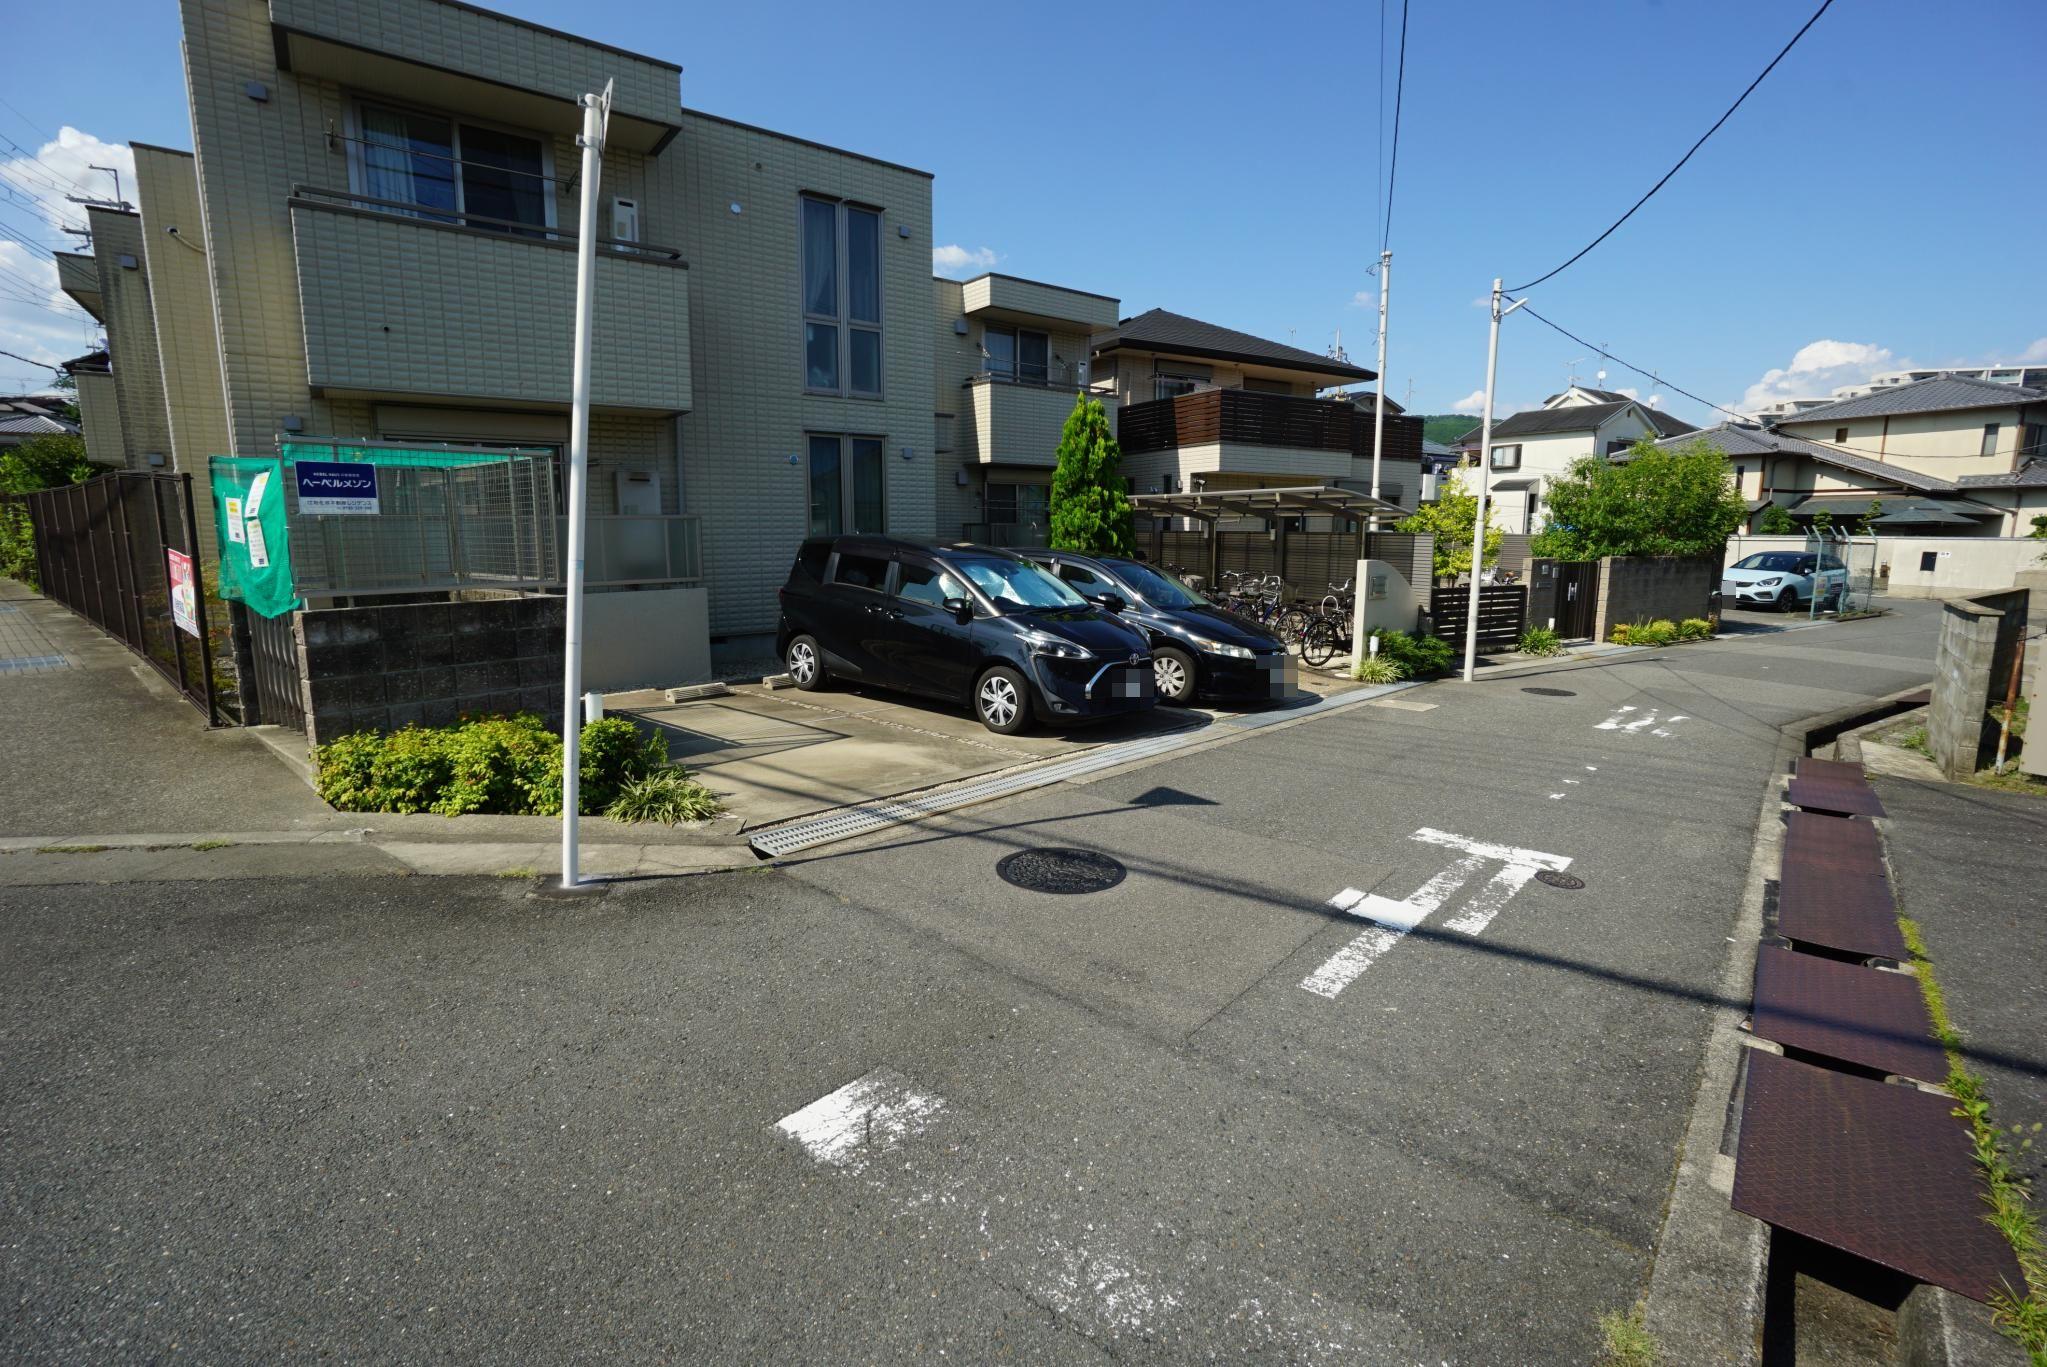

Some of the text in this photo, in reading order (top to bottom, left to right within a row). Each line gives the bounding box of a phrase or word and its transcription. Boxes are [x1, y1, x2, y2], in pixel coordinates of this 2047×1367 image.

[302, 478, 372, 488] ヘーベルメゾン
